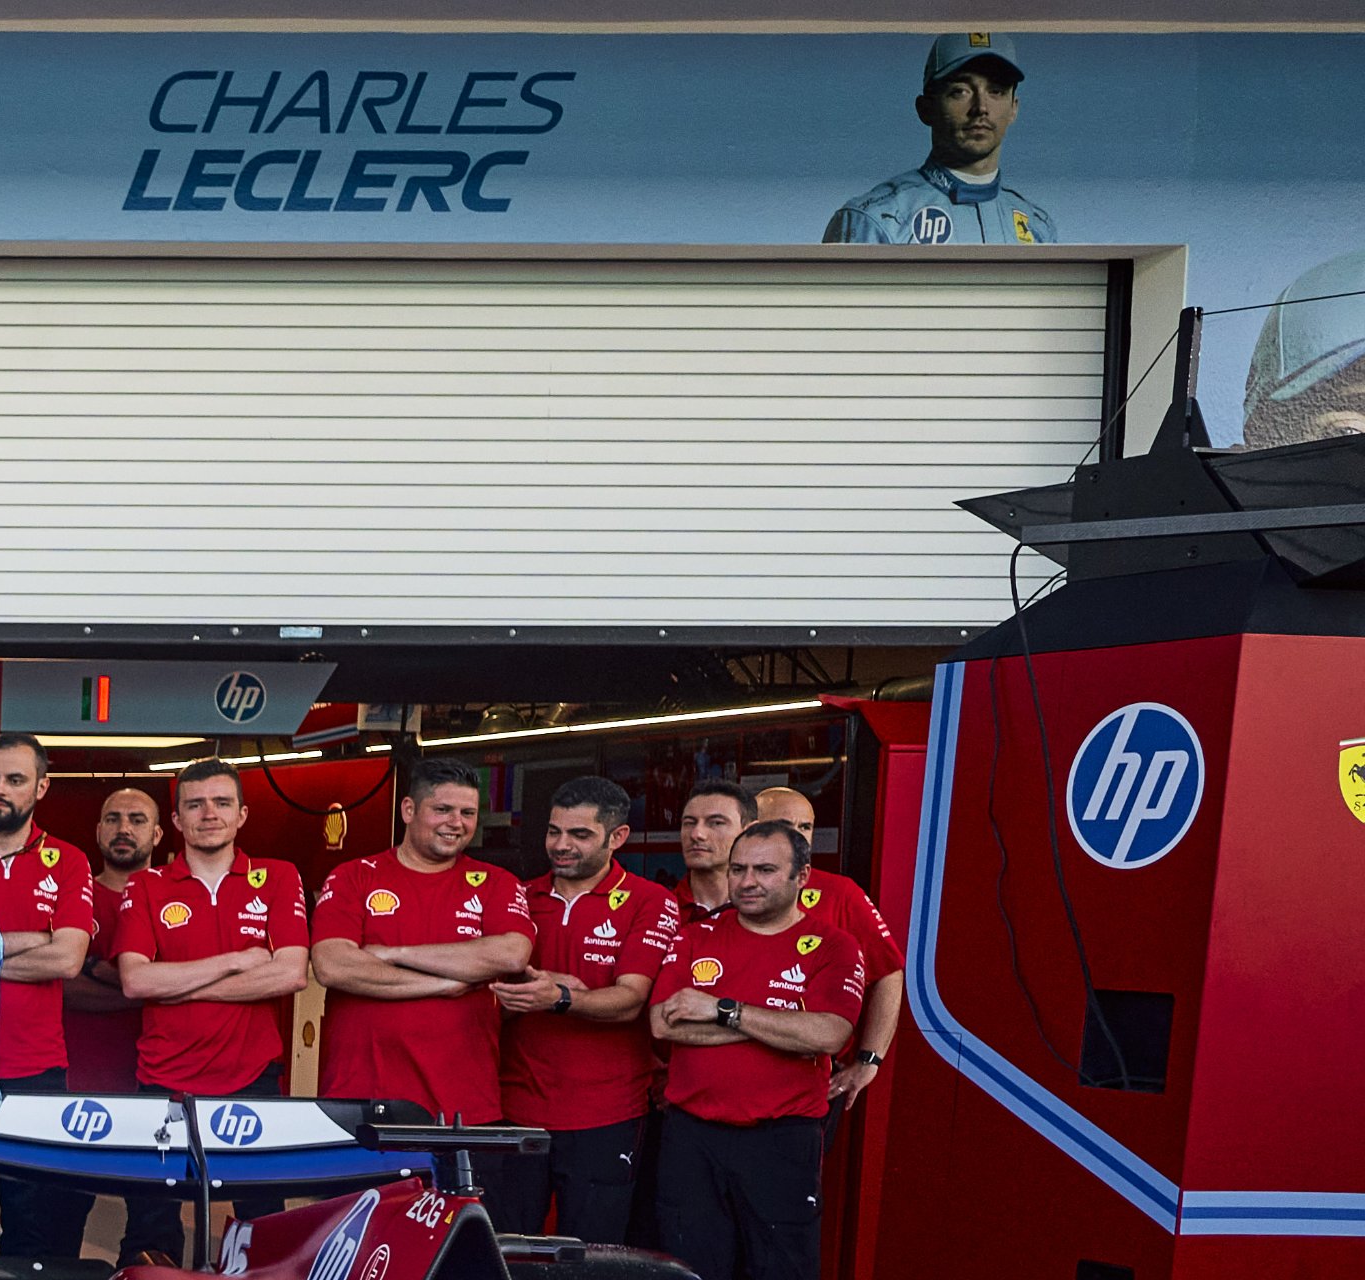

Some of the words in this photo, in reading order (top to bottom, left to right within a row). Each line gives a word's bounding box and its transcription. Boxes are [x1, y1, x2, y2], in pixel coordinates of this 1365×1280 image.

[148, 70, 575, 135] CHARLES
[122, 149, 529, 212] LECLERC
[218, 670, 262, 723] hp
[1080, 707, 1191, 863] hp
[65, 1099, 110, 1142] hp
[214, 1104, 259, 1146] hp
